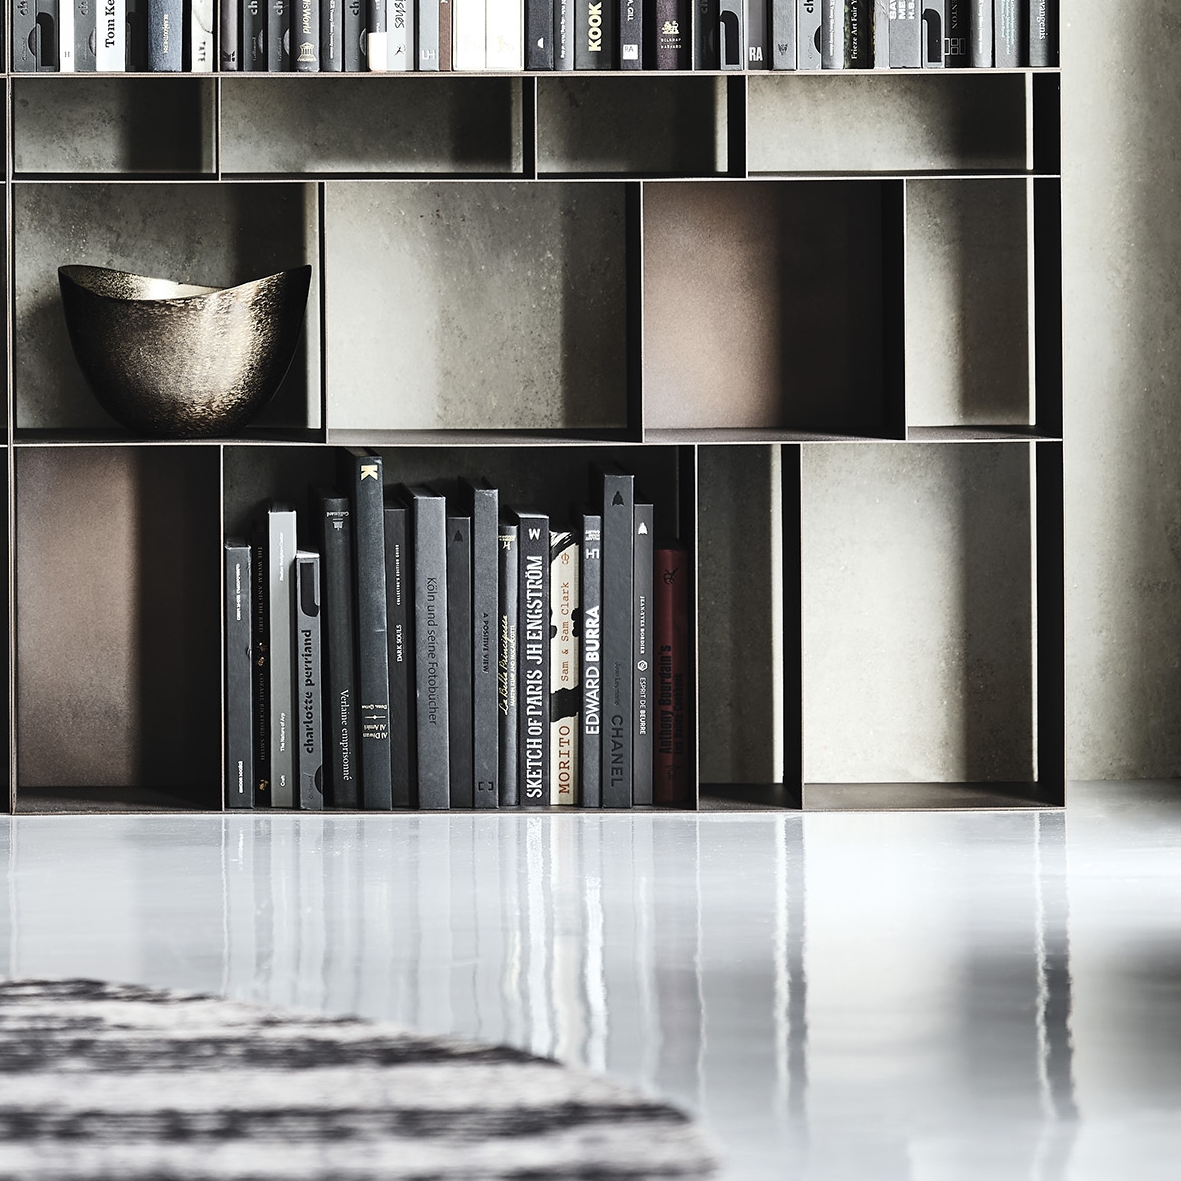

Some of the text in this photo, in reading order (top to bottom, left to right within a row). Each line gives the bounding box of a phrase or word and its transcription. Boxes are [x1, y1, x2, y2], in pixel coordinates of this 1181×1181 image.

[105, 24, 115, 48] Tom
[197, 41, 206, 62] TATE
[588, 3, 602, 52] KOOK
[749, 47, 763, 61] RA
[528, 528, 540, 540] W
[561, 581, 570, 615] Clark
[427, 577, 439, 726] Köln und seine Fotobücher
[561, 621, 569, 642] Sam
[498, 614, 513, 716] La Bella Principessa
[525, 555, 543, 798] SKETCH OF PARIS JH ENGSTRÖM
[561, 661, 569, 682] Sam
[585, 605, 600, 735] EDWARD BURRA
[301, 629, 315, 754] charlotte perriand
[639, 699, 646, 709] DE
[339, 689, 353, 781] Verlaine emprisonné
[611, 714, 624, 787] CHANEL
[658, 707, 674, 755] Anthony
[558, 725, 570, 794] MORITO
